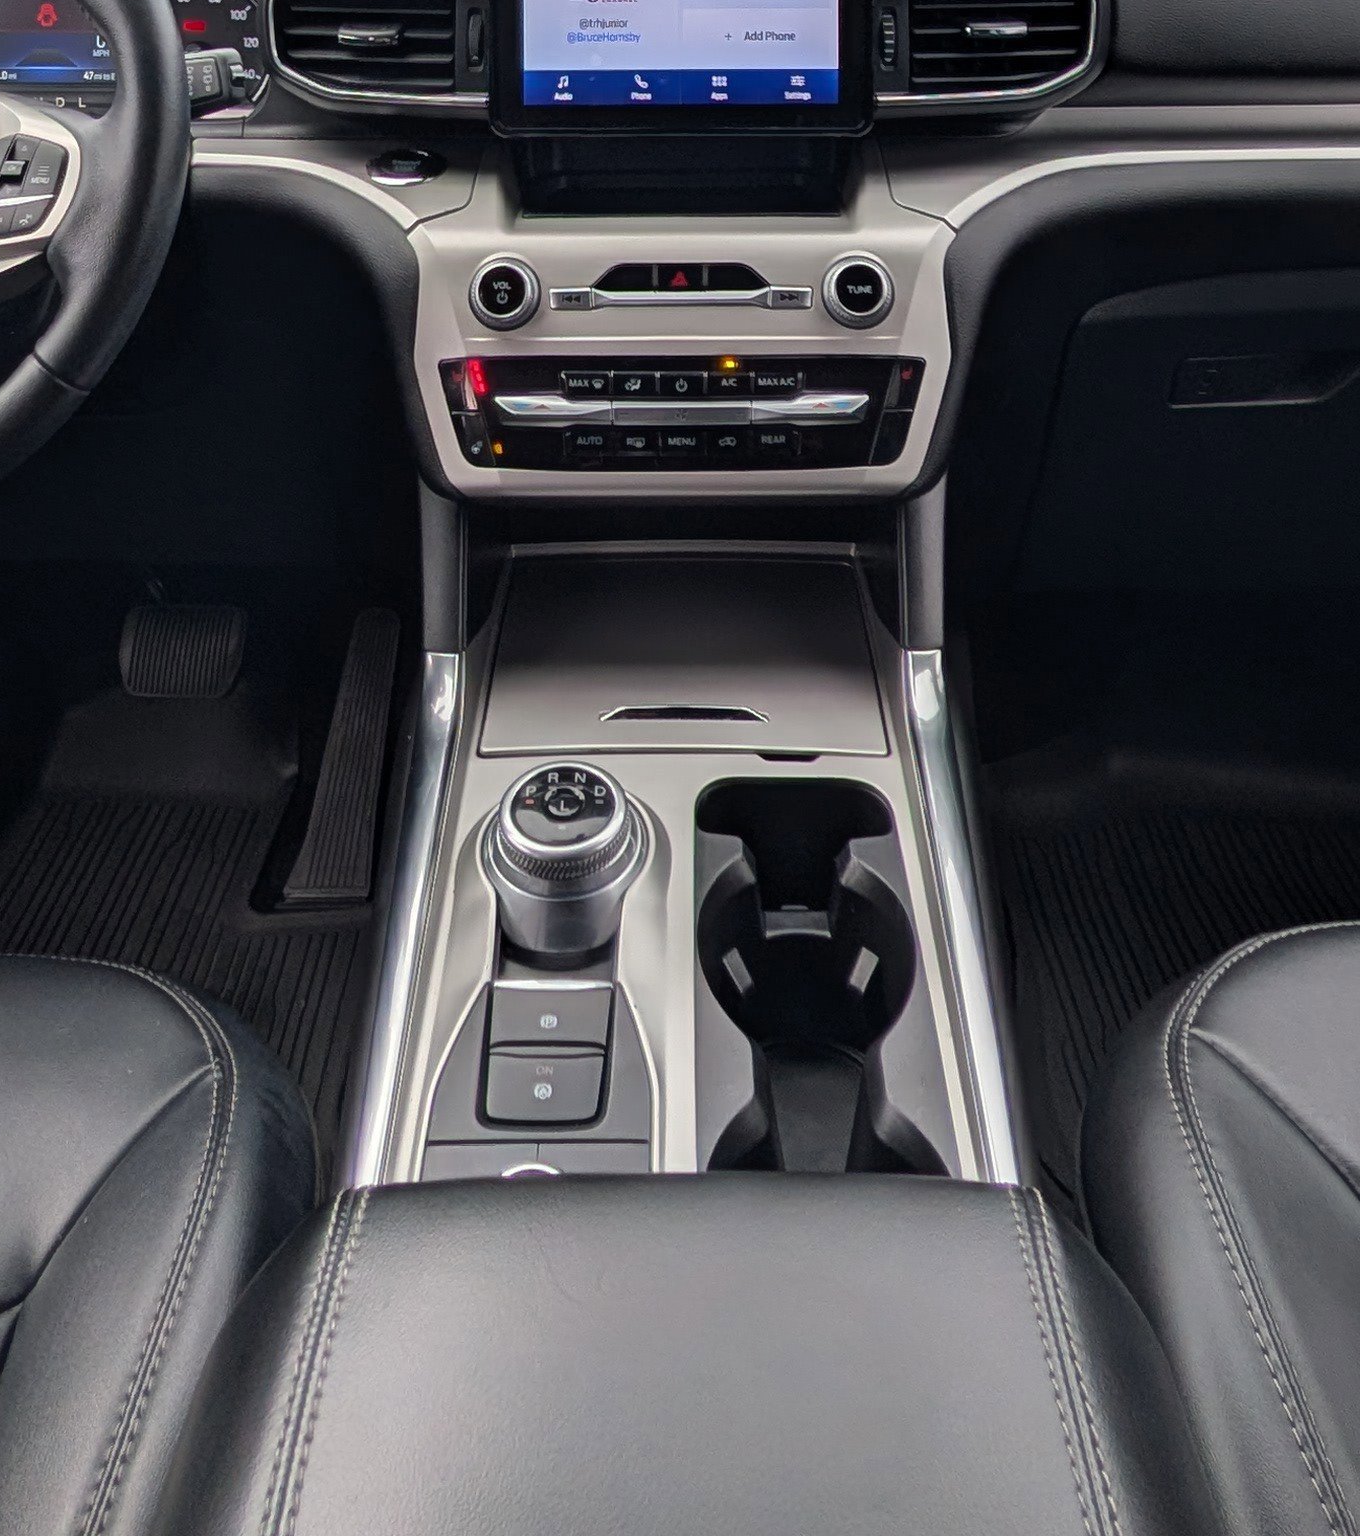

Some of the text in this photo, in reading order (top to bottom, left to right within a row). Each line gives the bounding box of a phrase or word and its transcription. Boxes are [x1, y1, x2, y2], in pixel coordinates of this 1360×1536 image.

[230, 9, 248, 21] 100
[743, 30, 796, 42] Add Phone
[243, 37, 259, 48] 120
[92, 49, 110, 57] MPH
[83, 71, 93, 81] 47
[55, 96, 87, 108] D L
[554, 91, 574, 102] Audio
[630, 91, 652, 102] Phone
[492, 281, 512, 290] VOL
[846, 285, 873, 294] TUNE
[568, 378, 589, 388] MAX
[721, 377, 738, 387] A/C
[757, 377, 796, 387] MAX A/C
[576, 436, 603, 446] AUTO
[667, 437, 697, 447] MENU
[761, 435, 786, 445] REAR
[547, 772, 559, 784] R
[574, 772, 587, 784] N
[525, 785, 537, 797] P
[594, 785, 607, 797] D
[560, 800, 570, 813] L
[536, 1065, 554, 1076] ON
